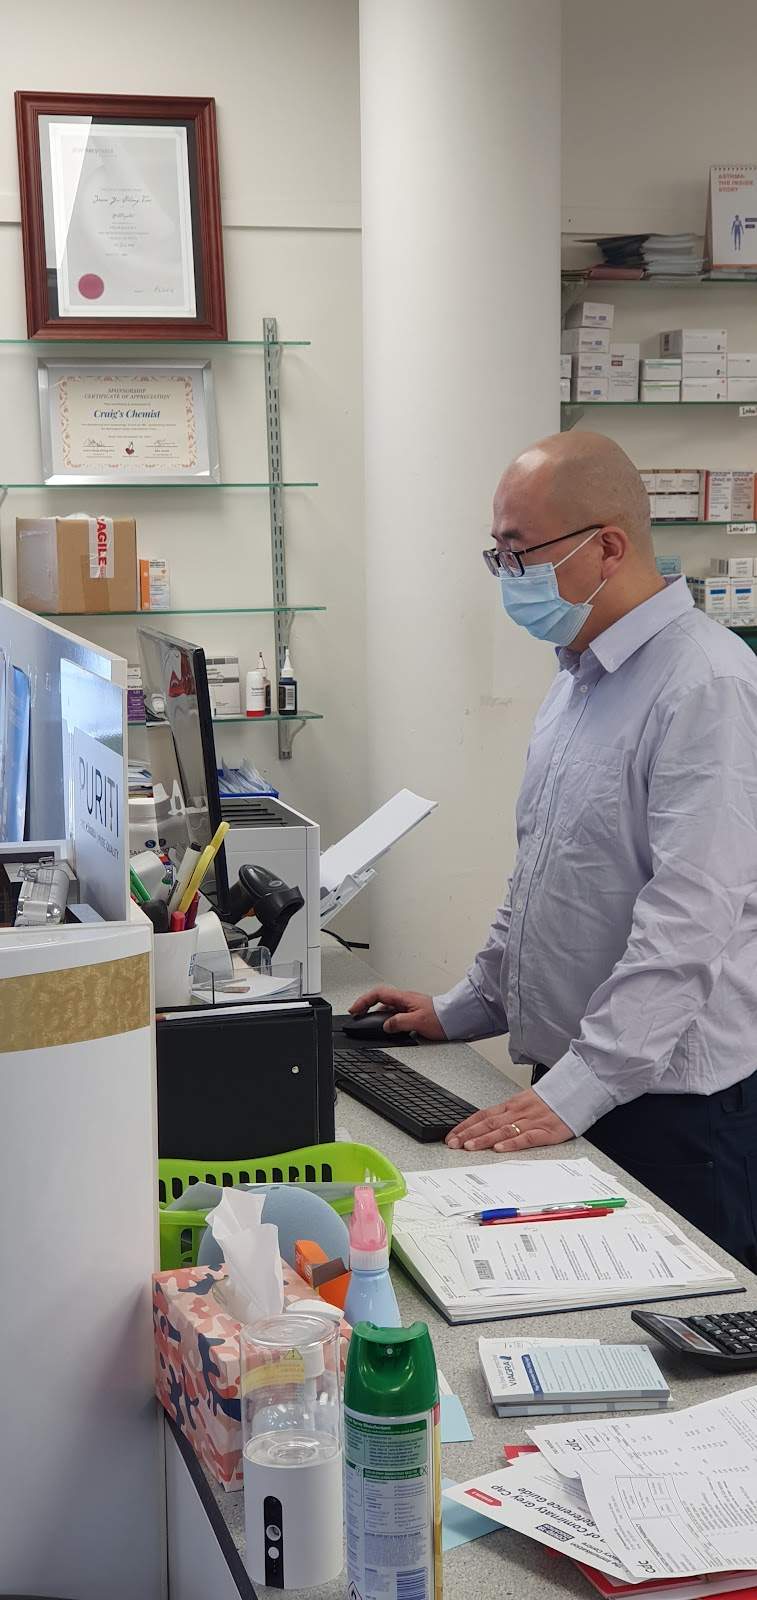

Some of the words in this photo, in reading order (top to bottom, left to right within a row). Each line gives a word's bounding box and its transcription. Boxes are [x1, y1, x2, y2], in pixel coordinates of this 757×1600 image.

[93, 409, 124, 419] Craig's
[126, 409, 161, 418] Chemist
[96, 518, 107, 566] AGILE
[79, 756, 119, 838] PURITI
[503, 1360, 517, 1387] VIAGRA
[490, 1484, 512, 1496] Cap
[512, 1494, 536, 1508] Grey
[518, 1487, 547, 1503] Guide
[535, 1505, 587, 1534] Comirnaty
[546, 1501, 597, 1528] Reference
